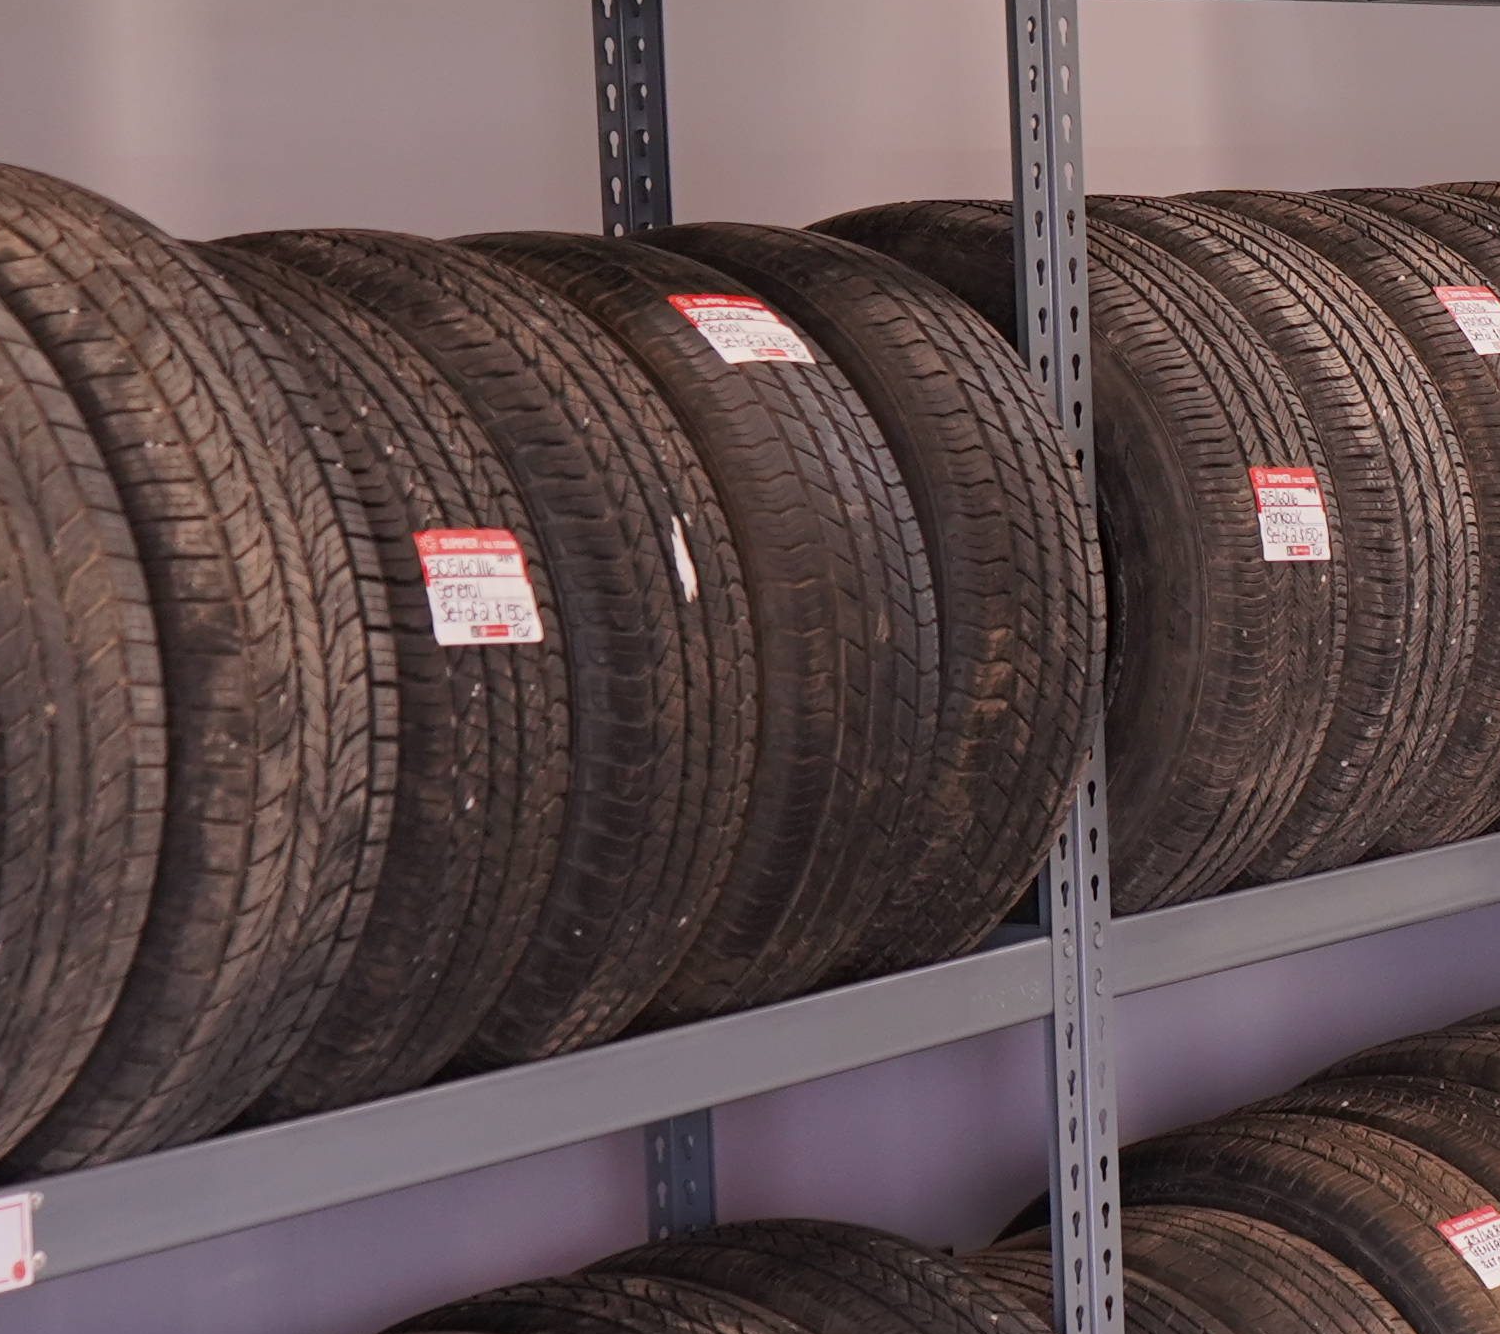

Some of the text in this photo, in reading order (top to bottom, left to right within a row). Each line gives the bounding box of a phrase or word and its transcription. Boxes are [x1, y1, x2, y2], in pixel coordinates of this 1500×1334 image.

[1267, 474, 1291, 483] SUMMER
[440, 538, 478, 549] SUMMER
[433, 580, 482, 600] General
